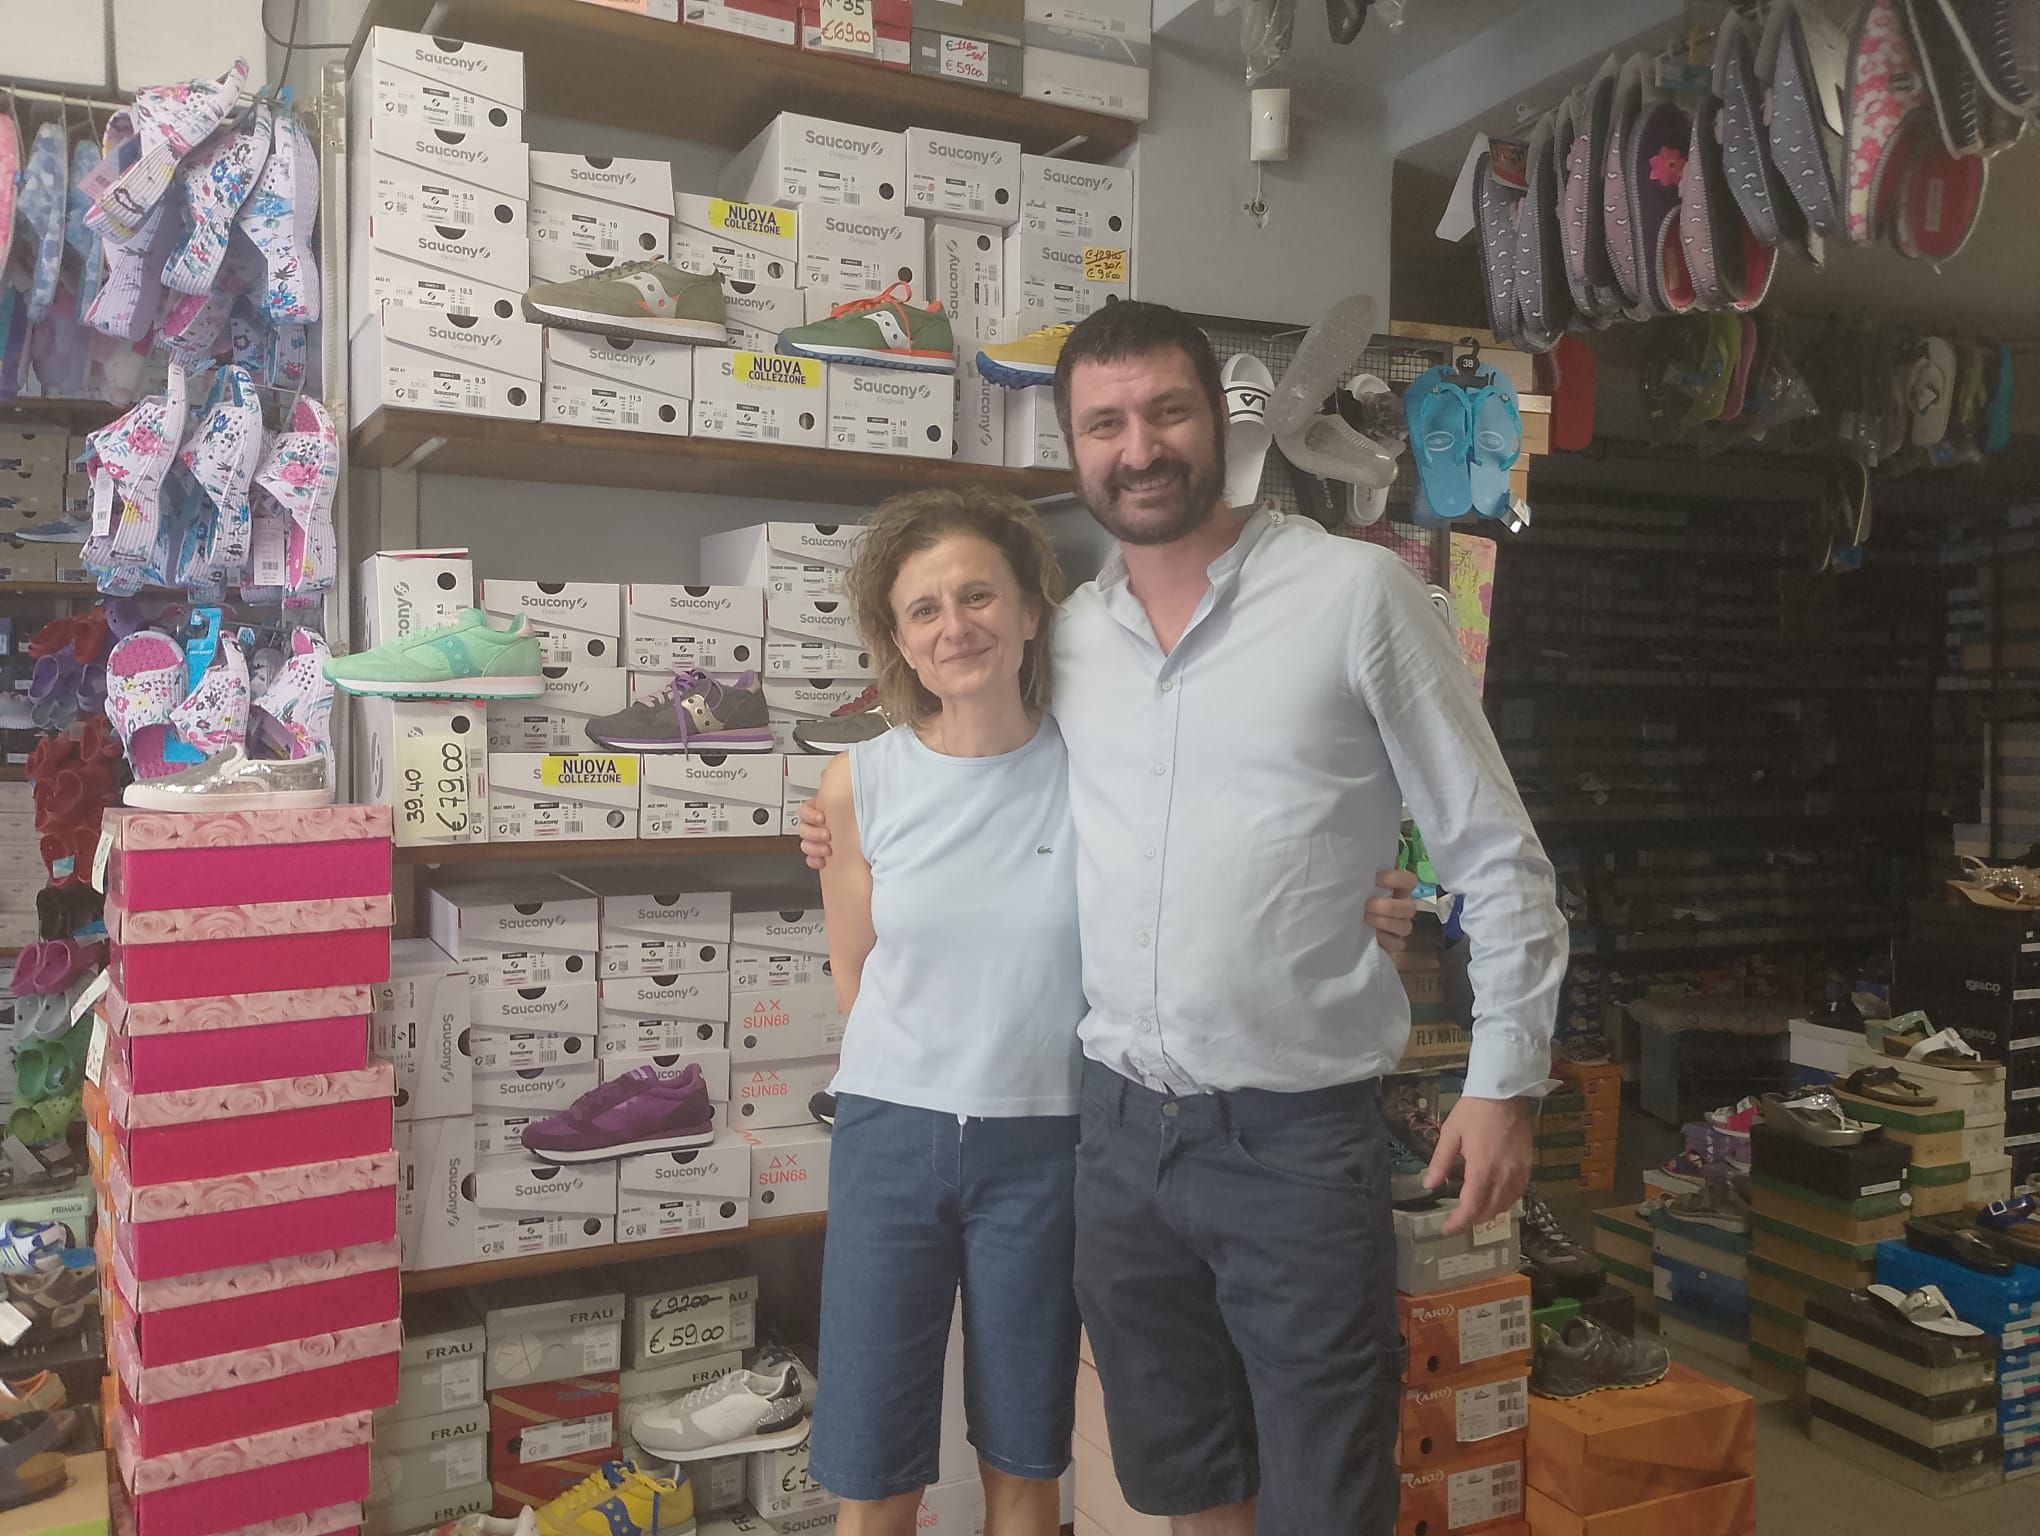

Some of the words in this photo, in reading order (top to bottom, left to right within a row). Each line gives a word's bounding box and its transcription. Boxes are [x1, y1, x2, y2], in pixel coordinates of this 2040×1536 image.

[416, 49, 476, 72] Saucony
[805, 130, 870, 155] Saucony
[416, 141, 476, 162] Saucony
[928, 141, 990, 165] Saucony
[570, 168, 625, 185] Saucony
[1043, 168, 1101, 191] Saucony
[729, 205, 776, 226] NUOVA
[724, 217, 781, 236] COLLEZIONE
[826, 217, 889, 240] Saucony
[418, 238, 479, 258] Saucony
[1042, 246, 1083, 265] Sauco
[949, 256, 960, 320] Saucony
[724, 295, 765, 311] aucony
[428, 326, 489, 346] Saucony
[589, 348, 645, 366] Saucony
[1462, 358, 1474, 368] 38
[753, 356, 802, 376] NUOVA
[748, 370, 807, 385] COLLEZIONE
[853, 377, 917, 399] Saucony
[979, 377, 990, 436] aucony
[801, 535, 847, 549] Saucony
[521, 595, 577, 609] Saucony
[670, 597, 721, 610] Saucony
[398, 597, 412, 638] cony
[800, 613, 846, 627] Saucony
[795, 690, 842, 703] Saucony
[563, 759, 617, 774] NUOVA
[686, 768, 738, 781] Saucony
[558, 773, 621, 784] COLLEZIONE
[638, 908, 690, 920] Saucony
[499, 916, 554, 930] Saucony
[766, 925, 814, 936] Saucony
[637, 988, 689, 1001] Saucony
[502, 1001, 557, 1015] Saucony
[743, 1014, 790, 1029] SUN68
[442, 1014, 454, 1074] Saucony
[1416, 1030, 1434, 1046] FLY
[500, 1079, 554, 1095] Saucony
[741, 1083, 787, 1098] SUN68
[655, 1165, 708, 1180] Saucony
[759, 1168, 807, 1185] SUN68
[447, 1157, 461, 1218] Saucony
[515, 1180, 572, 1197] Saucony
[729, 1291, 748, 1303] AU
[570, 1308, 613, 1324] FRAU
[426, 1342, 473, 1359] FRAU
[431, 1421, 477, 1440] FRAU
[434, 1501, 480, 1521] FRAU
[782, 1513, 838, 1535] Saucon
